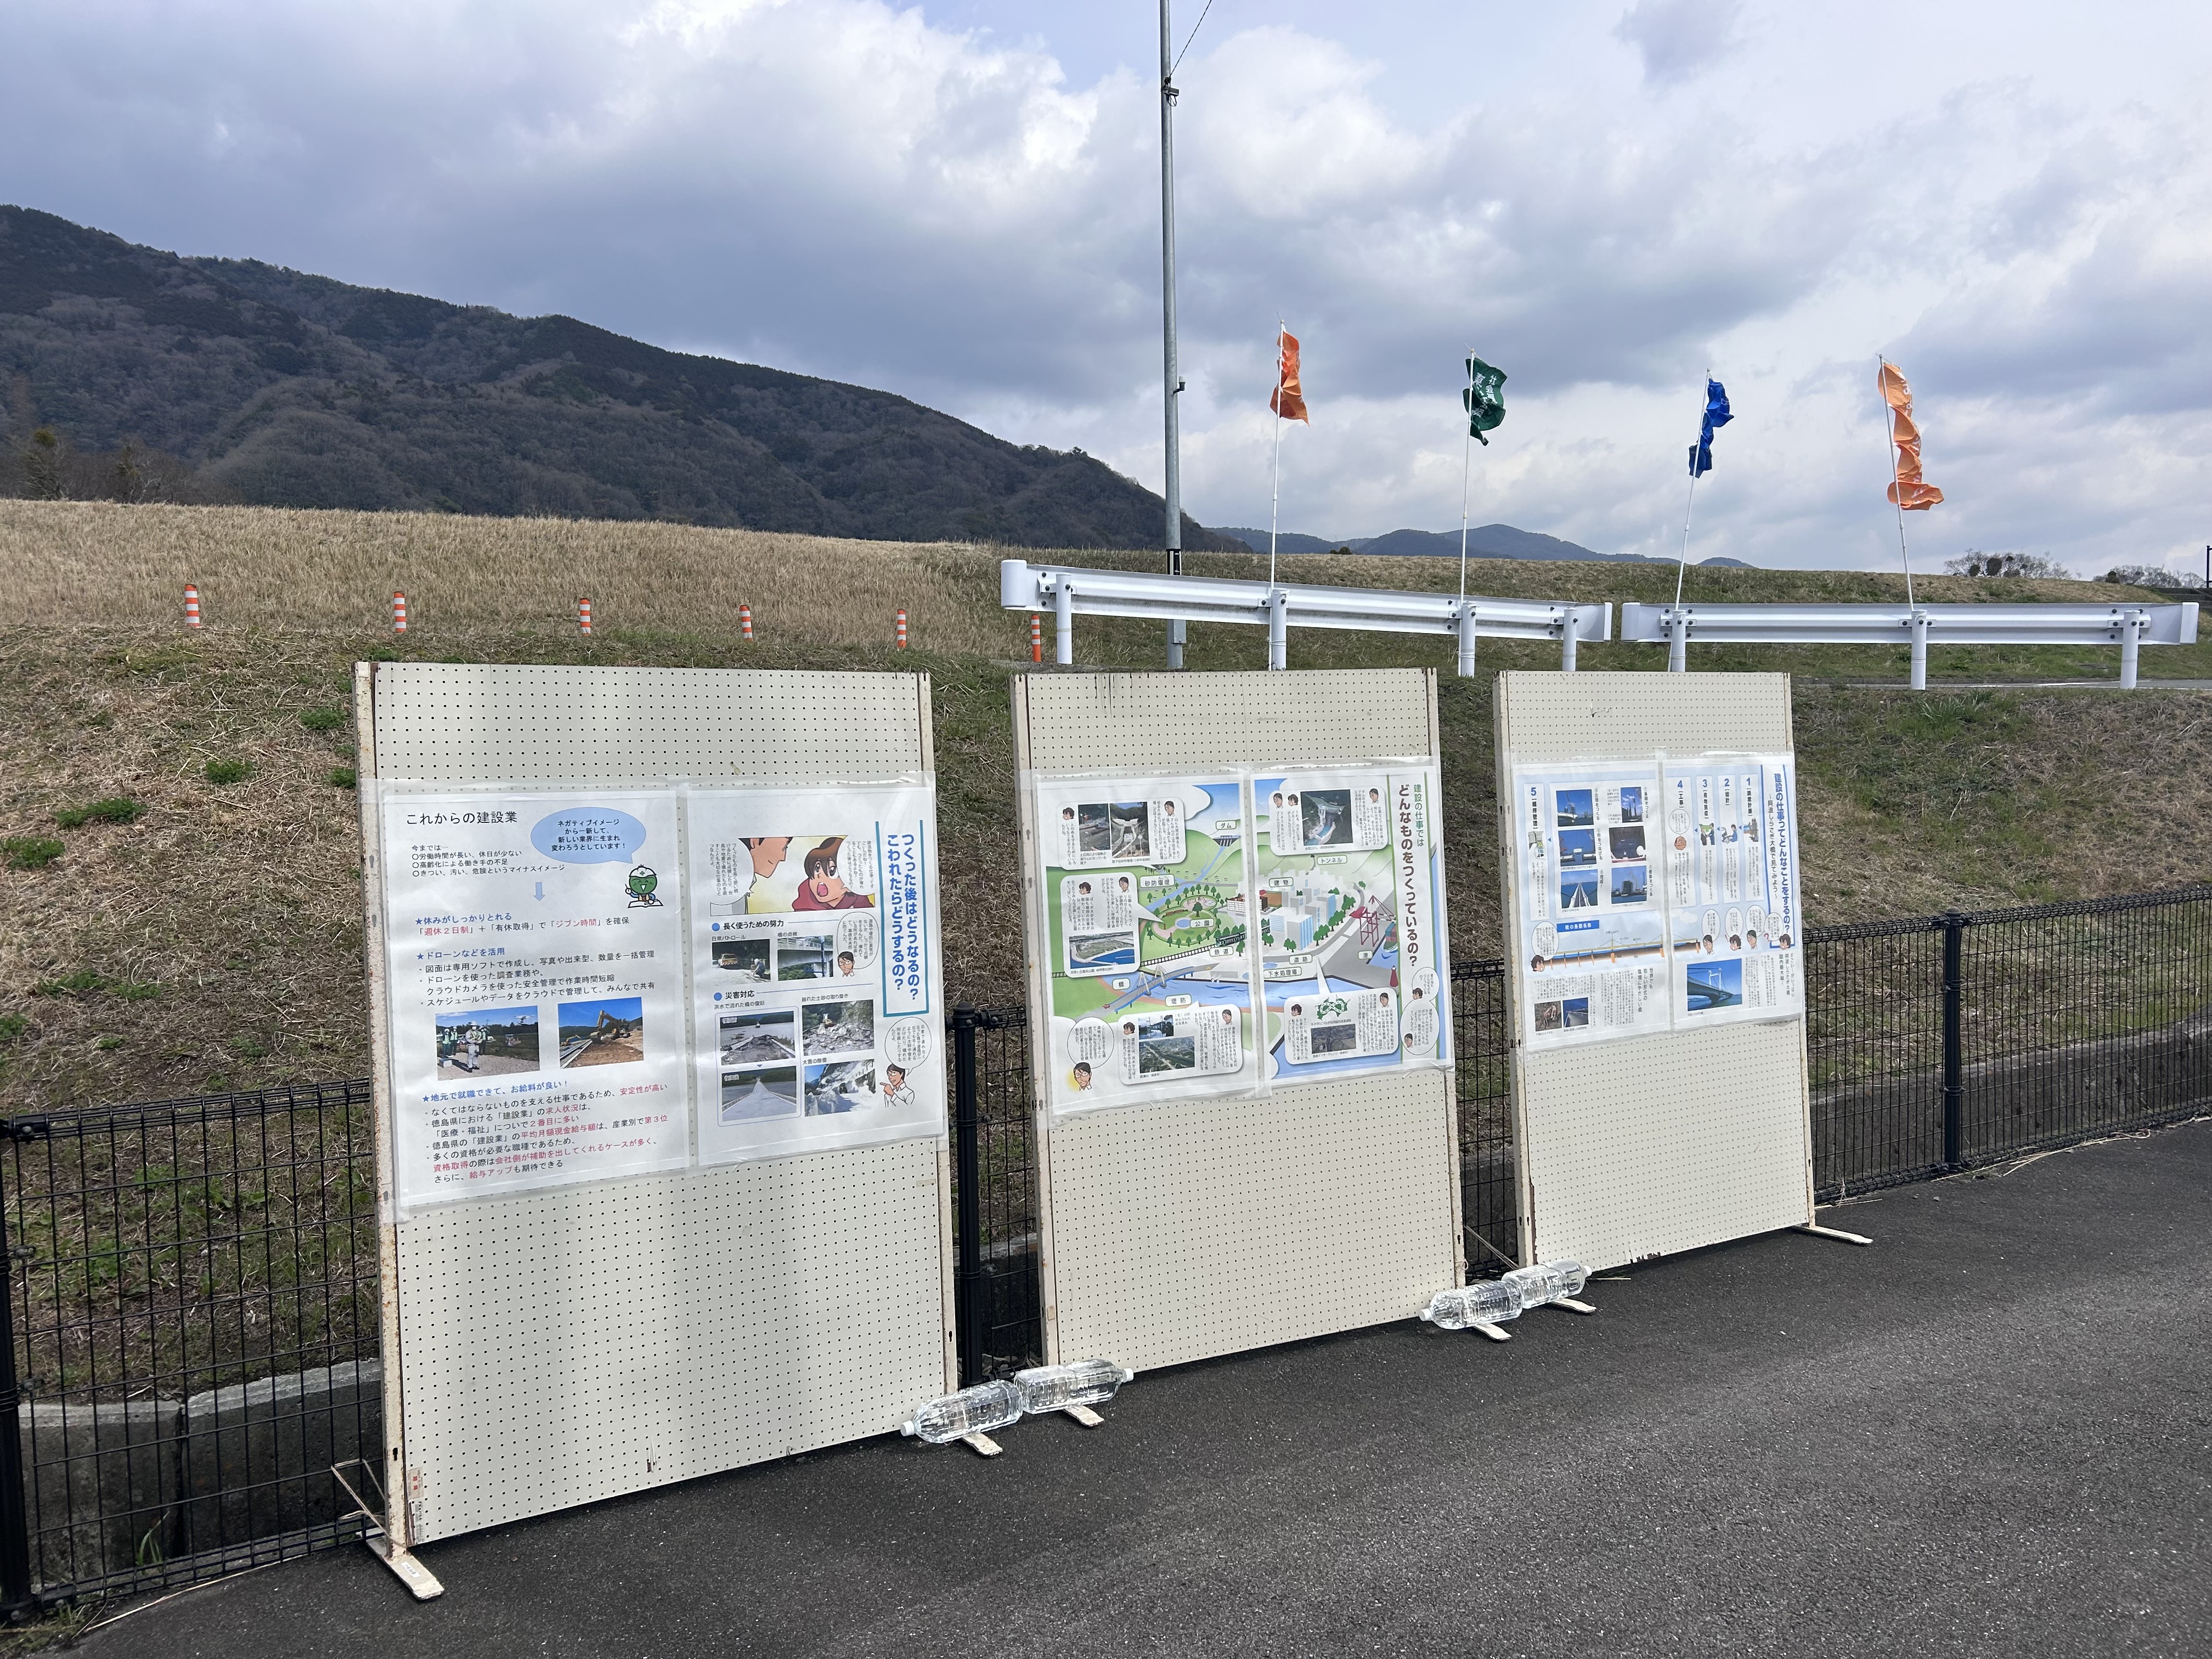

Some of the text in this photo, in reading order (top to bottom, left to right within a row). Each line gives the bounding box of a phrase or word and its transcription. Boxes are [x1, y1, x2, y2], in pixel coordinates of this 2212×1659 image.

[1677, 780, 1683, 788] 4
[1702, 779, 1708, 788] 3
[1724, 778, 1730, 787] 2
[1746, 777, 1751, 786] 1
[1531, 787, 1537, 796] 5
[407, 811, 517, 825] これからの建設業
[1413, 784, 1425, 847] 建設の仕事では
[551, 843, 626, 851] 変わろうとしています！
[1774, 773, 1791, 933] 建設の仕事ってどんなことをするの？
[1398, 784, 1419, 967] どんなものをつくっているの？
[887, 834, 905, 990] こわれたらどうするの？
[901, 834, 920, 1000] つくった後はどうなるの？
[723, 919, 784, 930] 長く使うための努力
[1268, 969, 1297, 977] 下水処理場
[427, 974, 615, 996] クラウドカメラを使った安全管理で作業時間短縮
[725, 990, 755, 1000] 災害対応
[435, 1159, 563, 1183] さらに、給与アップも期待できる
